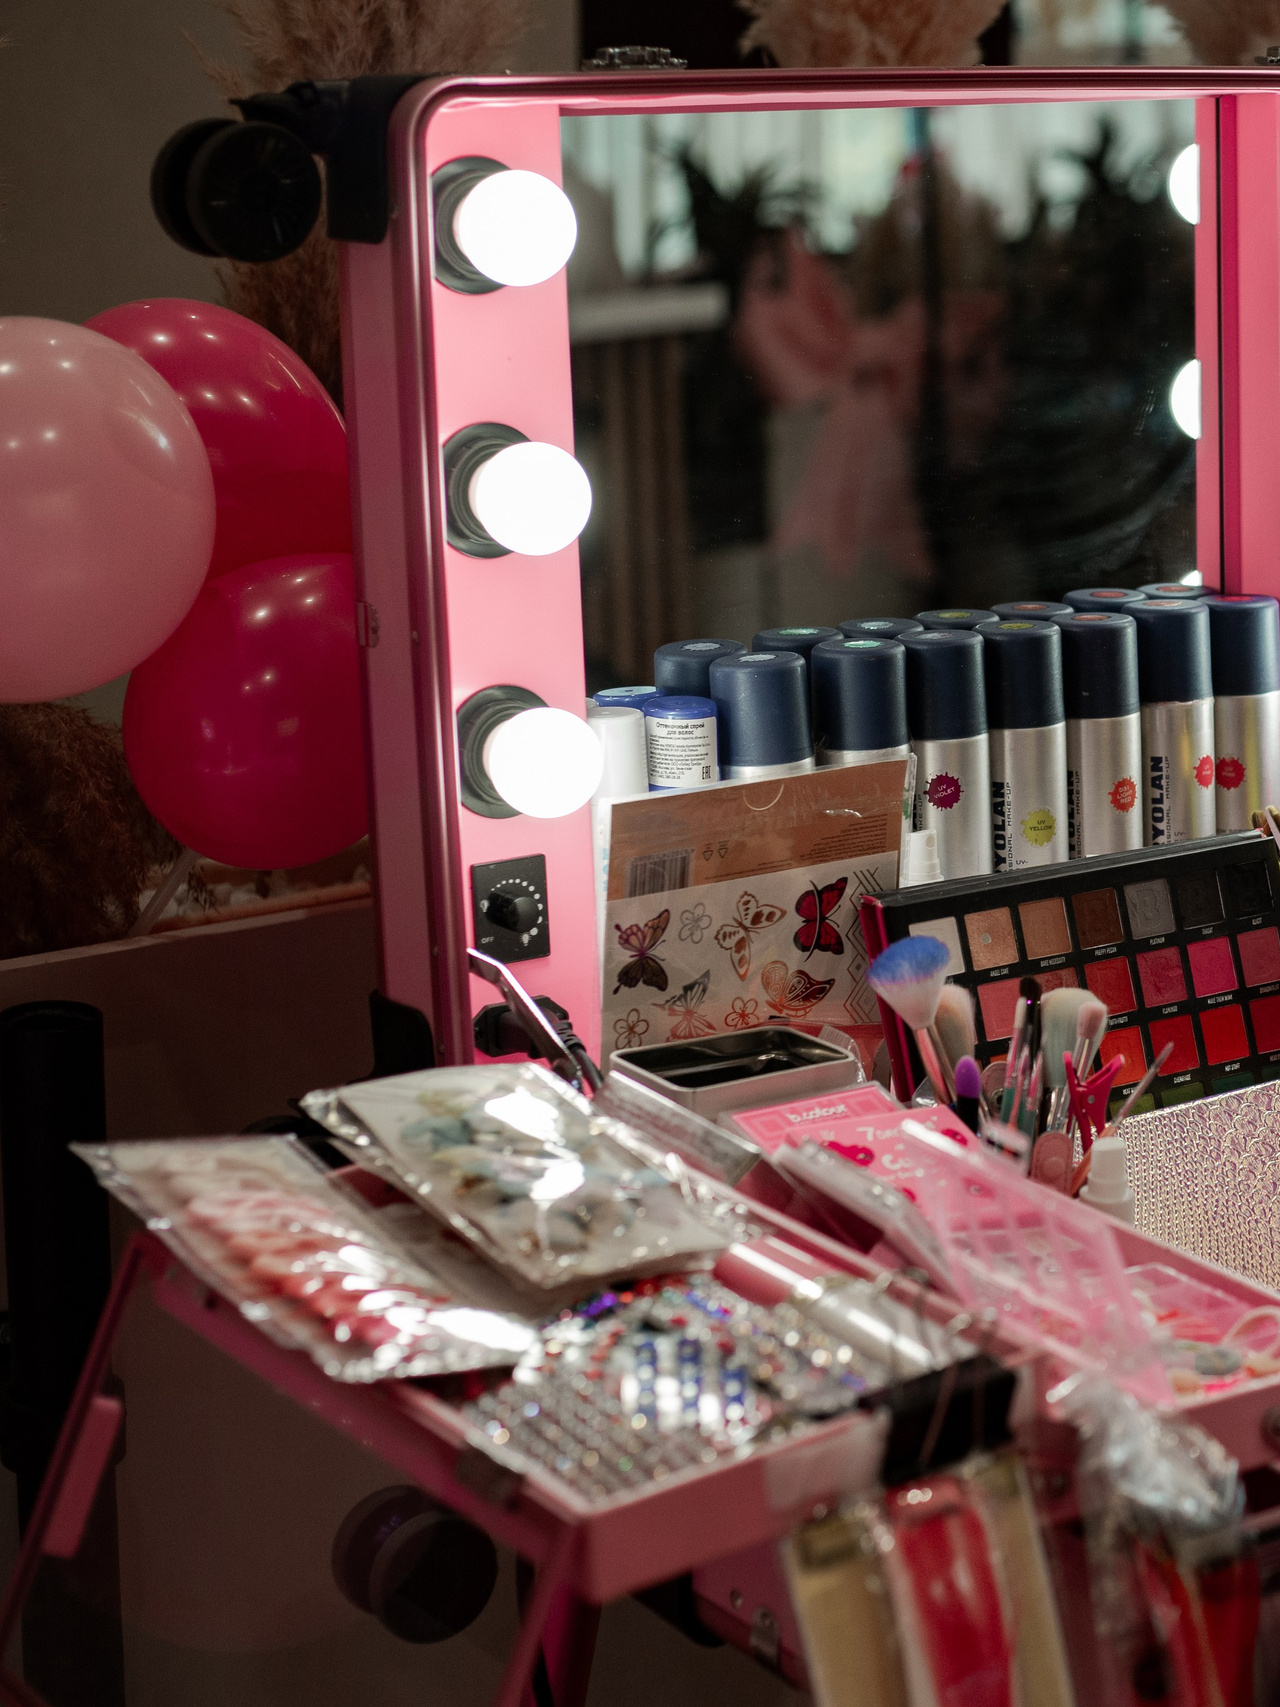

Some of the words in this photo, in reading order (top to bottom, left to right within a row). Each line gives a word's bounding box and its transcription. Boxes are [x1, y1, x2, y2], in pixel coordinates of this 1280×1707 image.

[656, 721, 689, 730] Оттеночный
[690, 722, 705, 730] спрей
[934, 786, 955, 798] VIOLET
[1117, 790, 1132, 799] LIGHT
[1120, 796, 1131, 804] RED
[1151, 756, 1164, 846] YOLAN
[993, 781, 1006, 873] YOLAN
[481, 936, 495, 944] OFF
[1040, 959, 1049, 967] BARE
